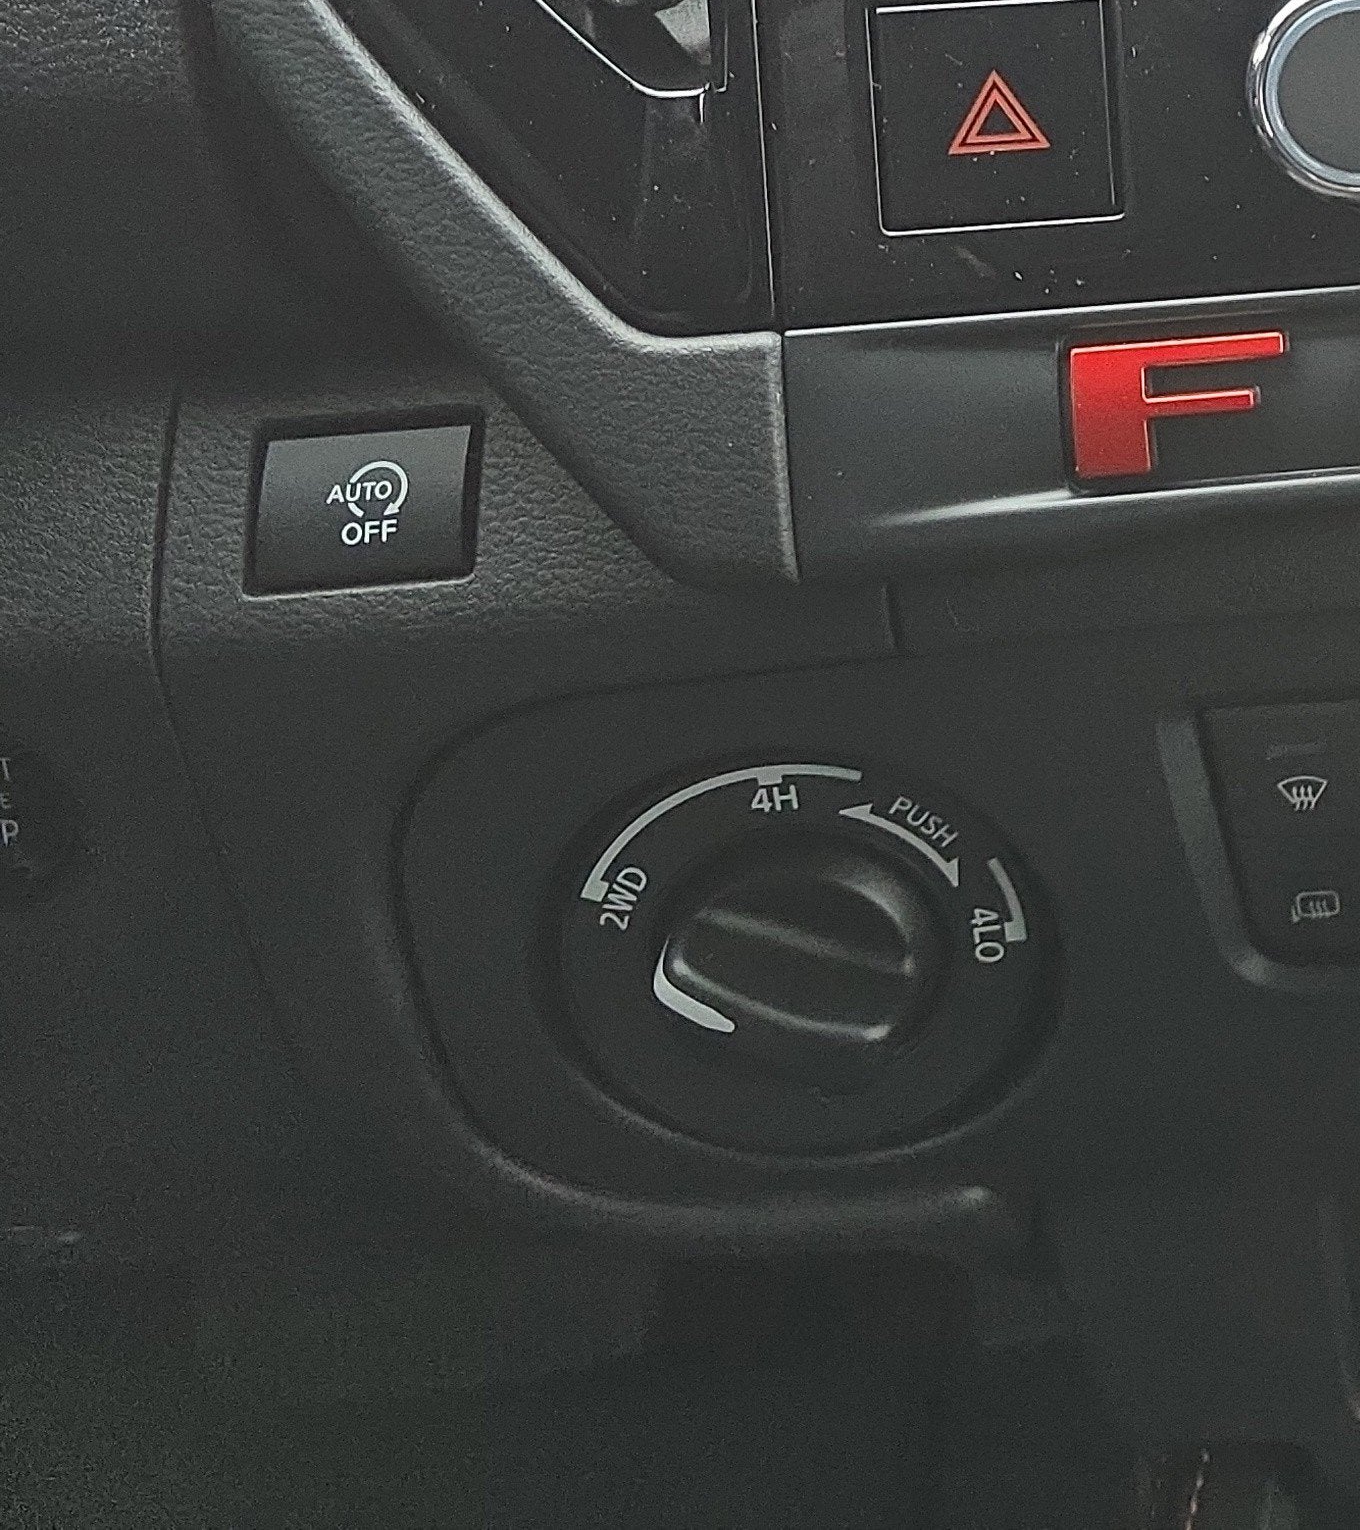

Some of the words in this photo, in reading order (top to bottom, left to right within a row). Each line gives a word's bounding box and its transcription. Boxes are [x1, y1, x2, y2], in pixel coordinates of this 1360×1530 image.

[326, 480, 393, 505] AUTO
[340, 518, 398, 547] OFF
[751, 784, 799, 813] 4H
[889, 796, 958, 849] PUSH
[600, 866, 648, 931] 2WD
[970, 907, 1005, 964] 4LO
